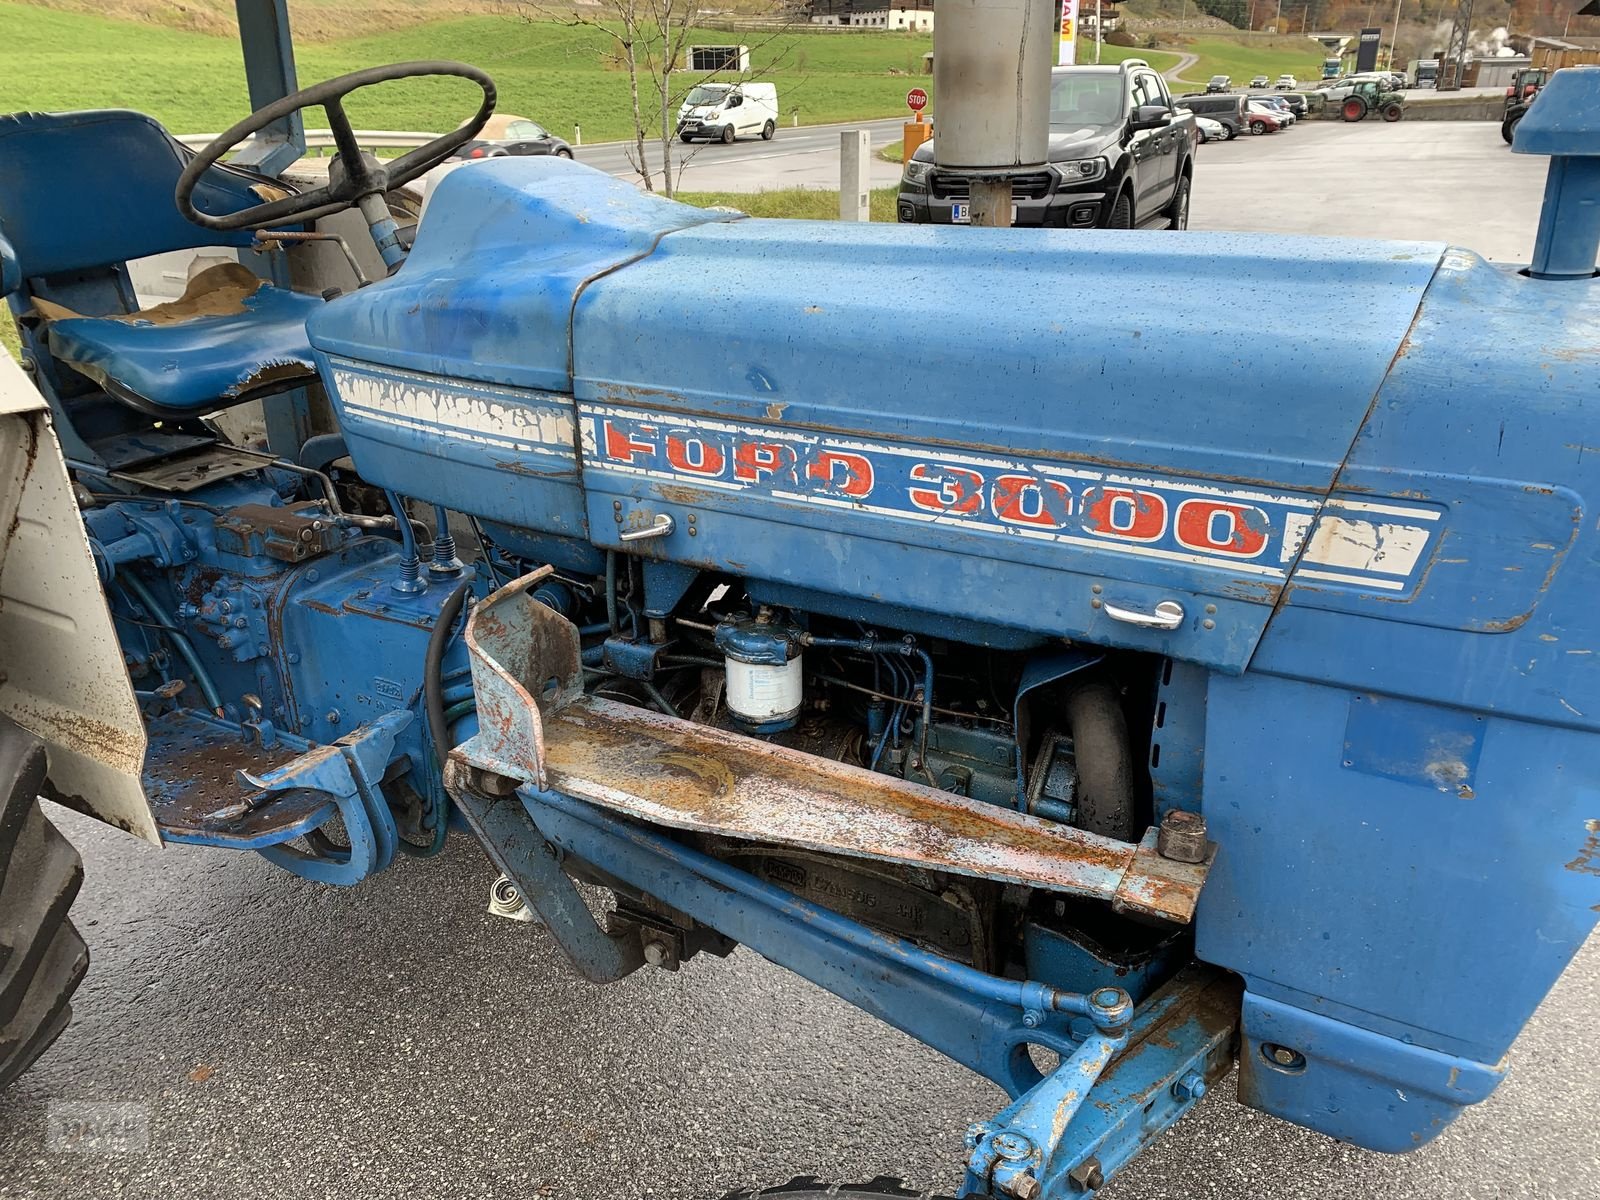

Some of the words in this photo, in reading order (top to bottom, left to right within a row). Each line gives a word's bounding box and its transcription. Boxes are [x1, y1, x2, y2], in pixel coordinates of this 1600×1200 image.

[1062, 0, 1071, 35] AM
[908, 94, 926, 105] STOP
[603, 419, 873, 499] FORD
[908, 463, 1267, 559] 3000
